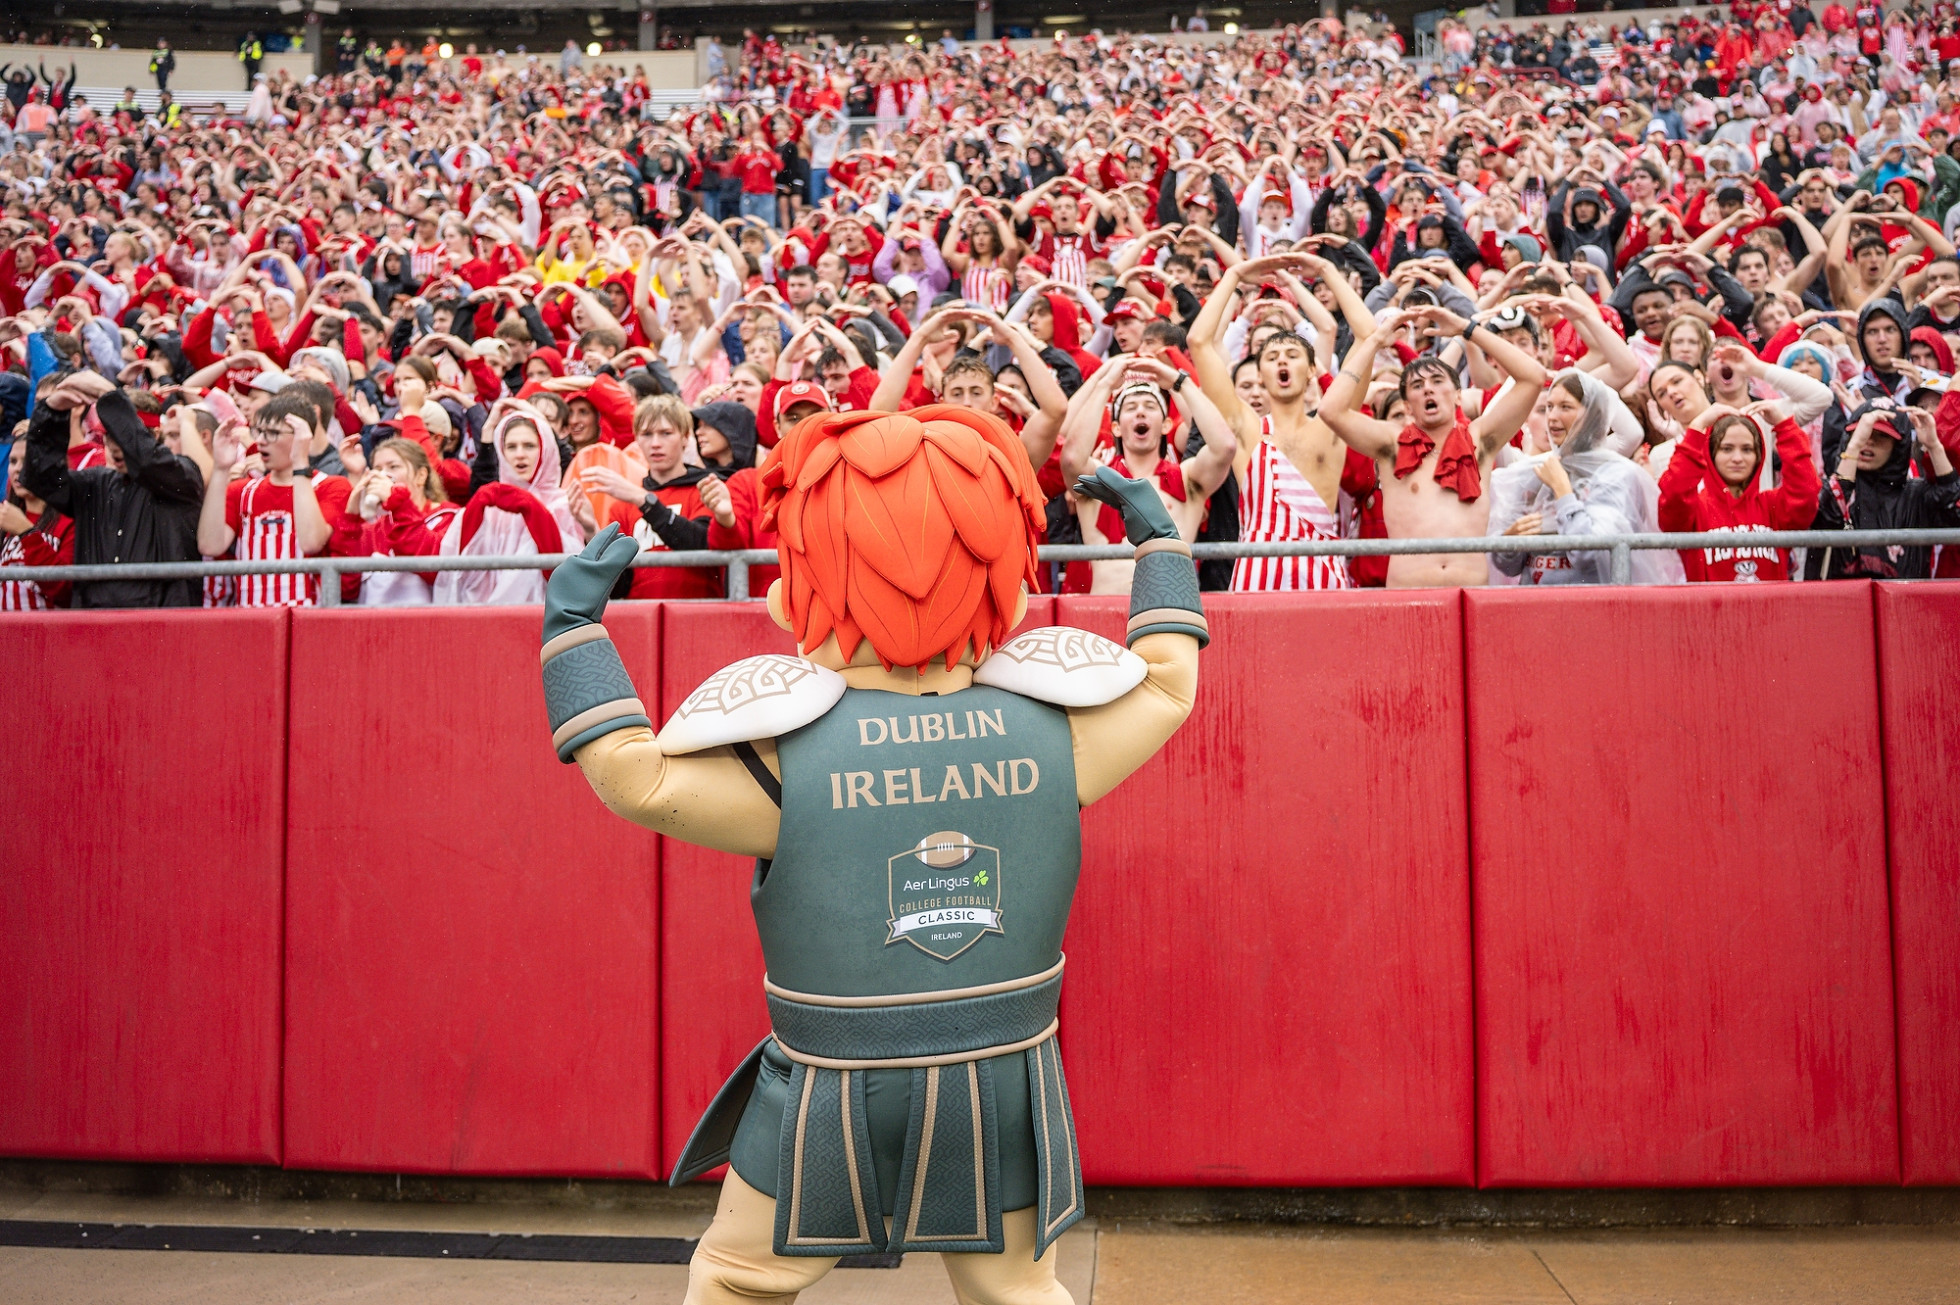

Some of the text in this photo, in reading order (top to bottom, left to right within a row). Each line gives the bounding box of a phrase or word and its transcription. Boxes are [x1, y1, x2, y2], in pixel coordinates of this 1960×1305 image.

[856, 708, 1008, 746] DUBLIN
[829, 757, 1040, 810] IRELAND
[903, 877, 970, 892] Aer Lingus
[899, 895, 992, 914] COLLEGE FOOTBALL
[917, 911, 976, 925] CLASSIC
[931, 932, 963, 941] IRELAND
